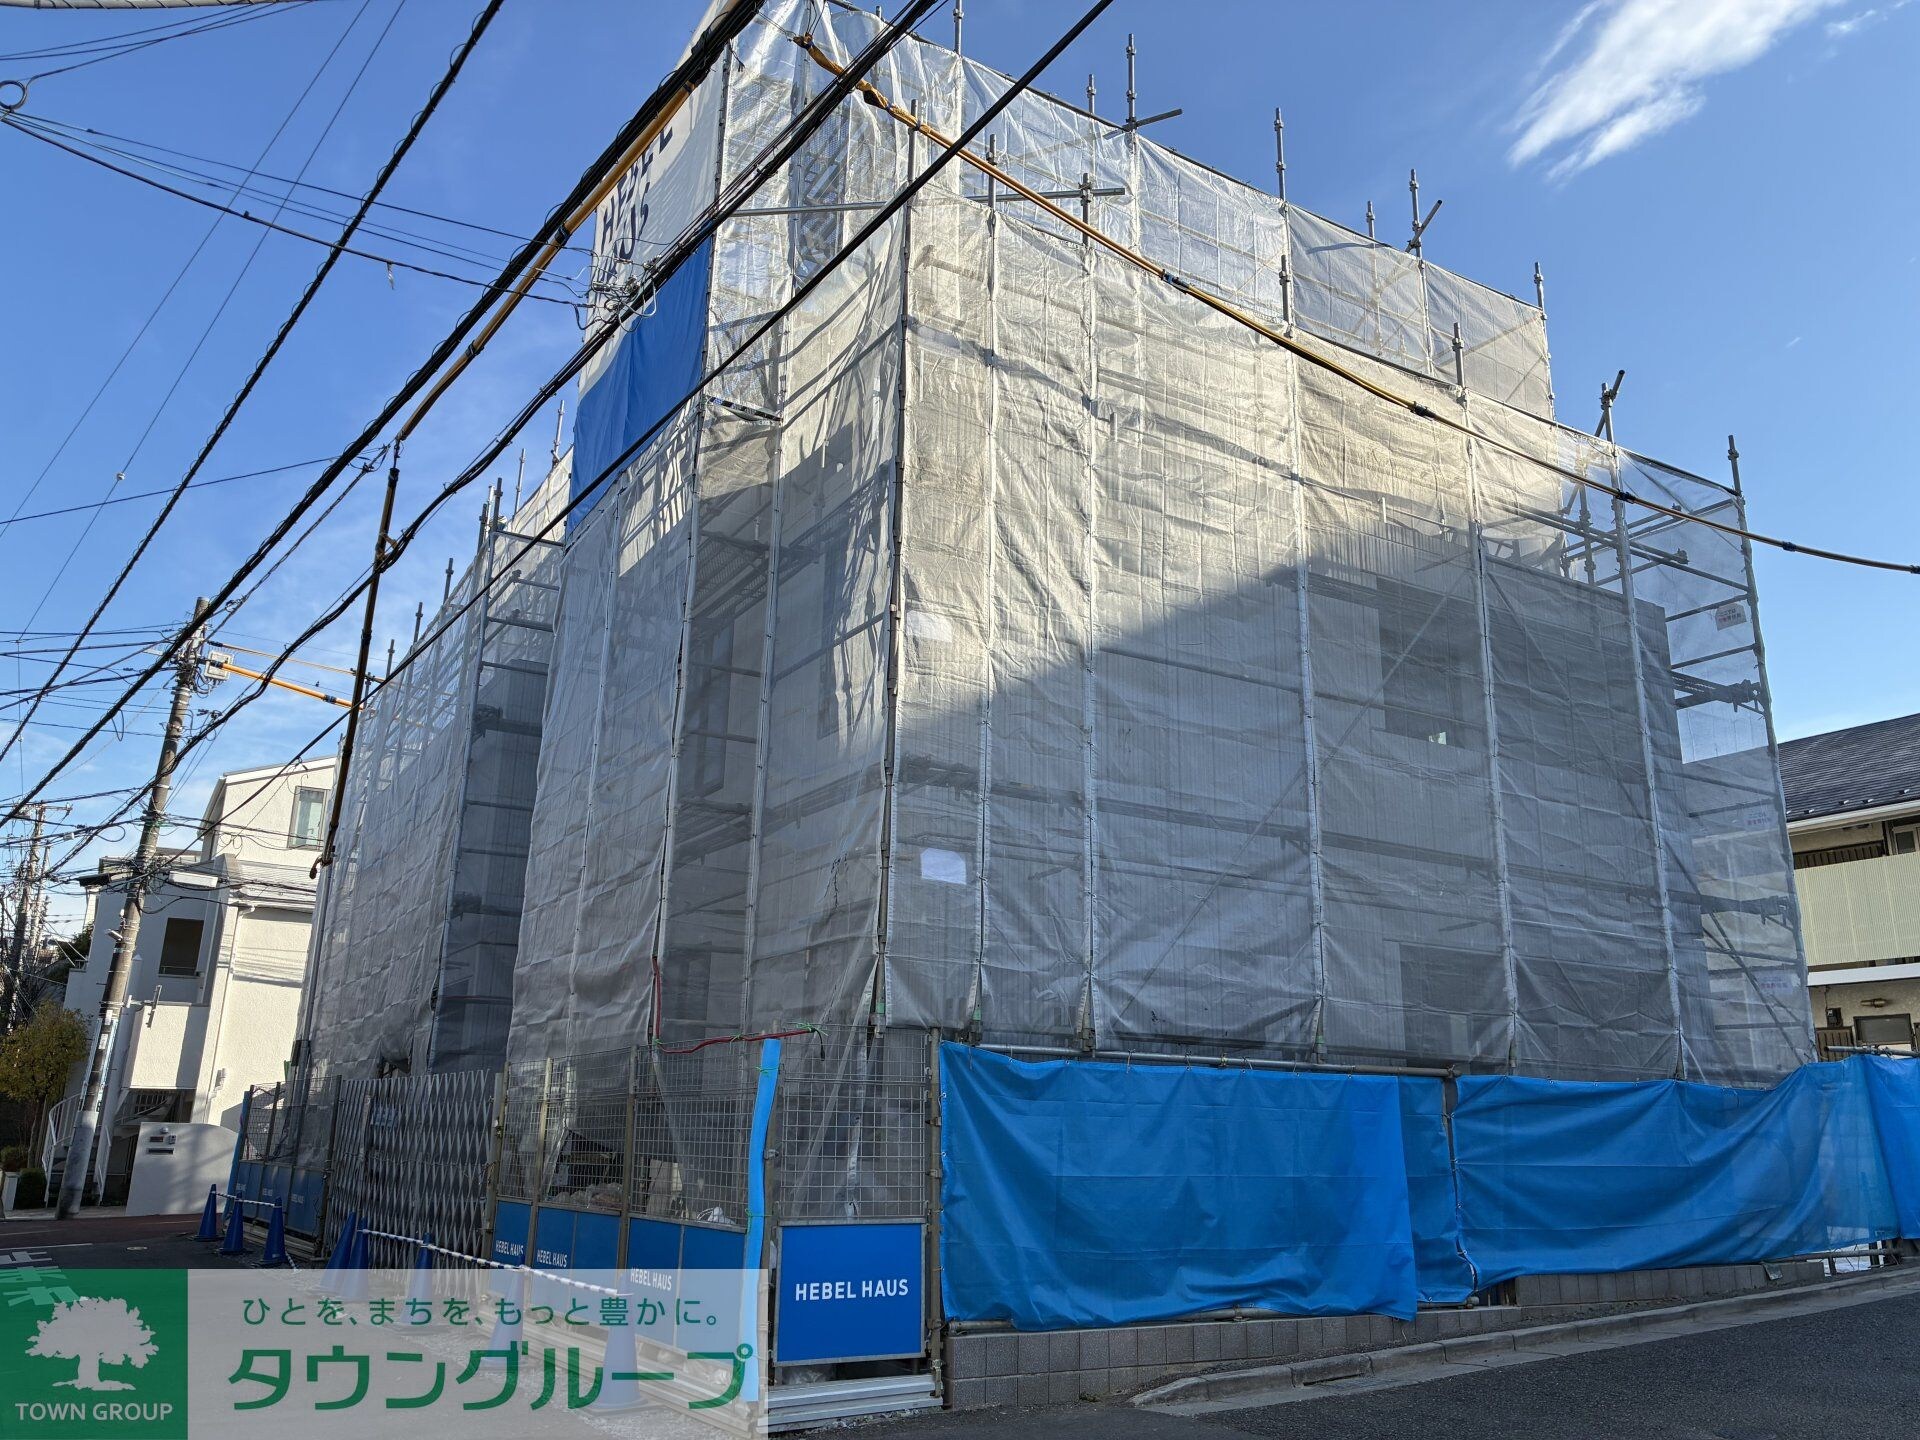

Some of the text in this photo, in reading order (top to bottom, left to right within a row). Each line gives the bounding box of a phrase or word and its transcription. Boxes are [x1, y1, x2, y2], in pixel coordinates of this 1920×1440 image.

[536, 1249, 567, 1268] HEBEL HAUS
[630, 1267, 672, 1291] HEBEL HAUS
[796, 1279, 909, 1301] HEBEL HAUS
